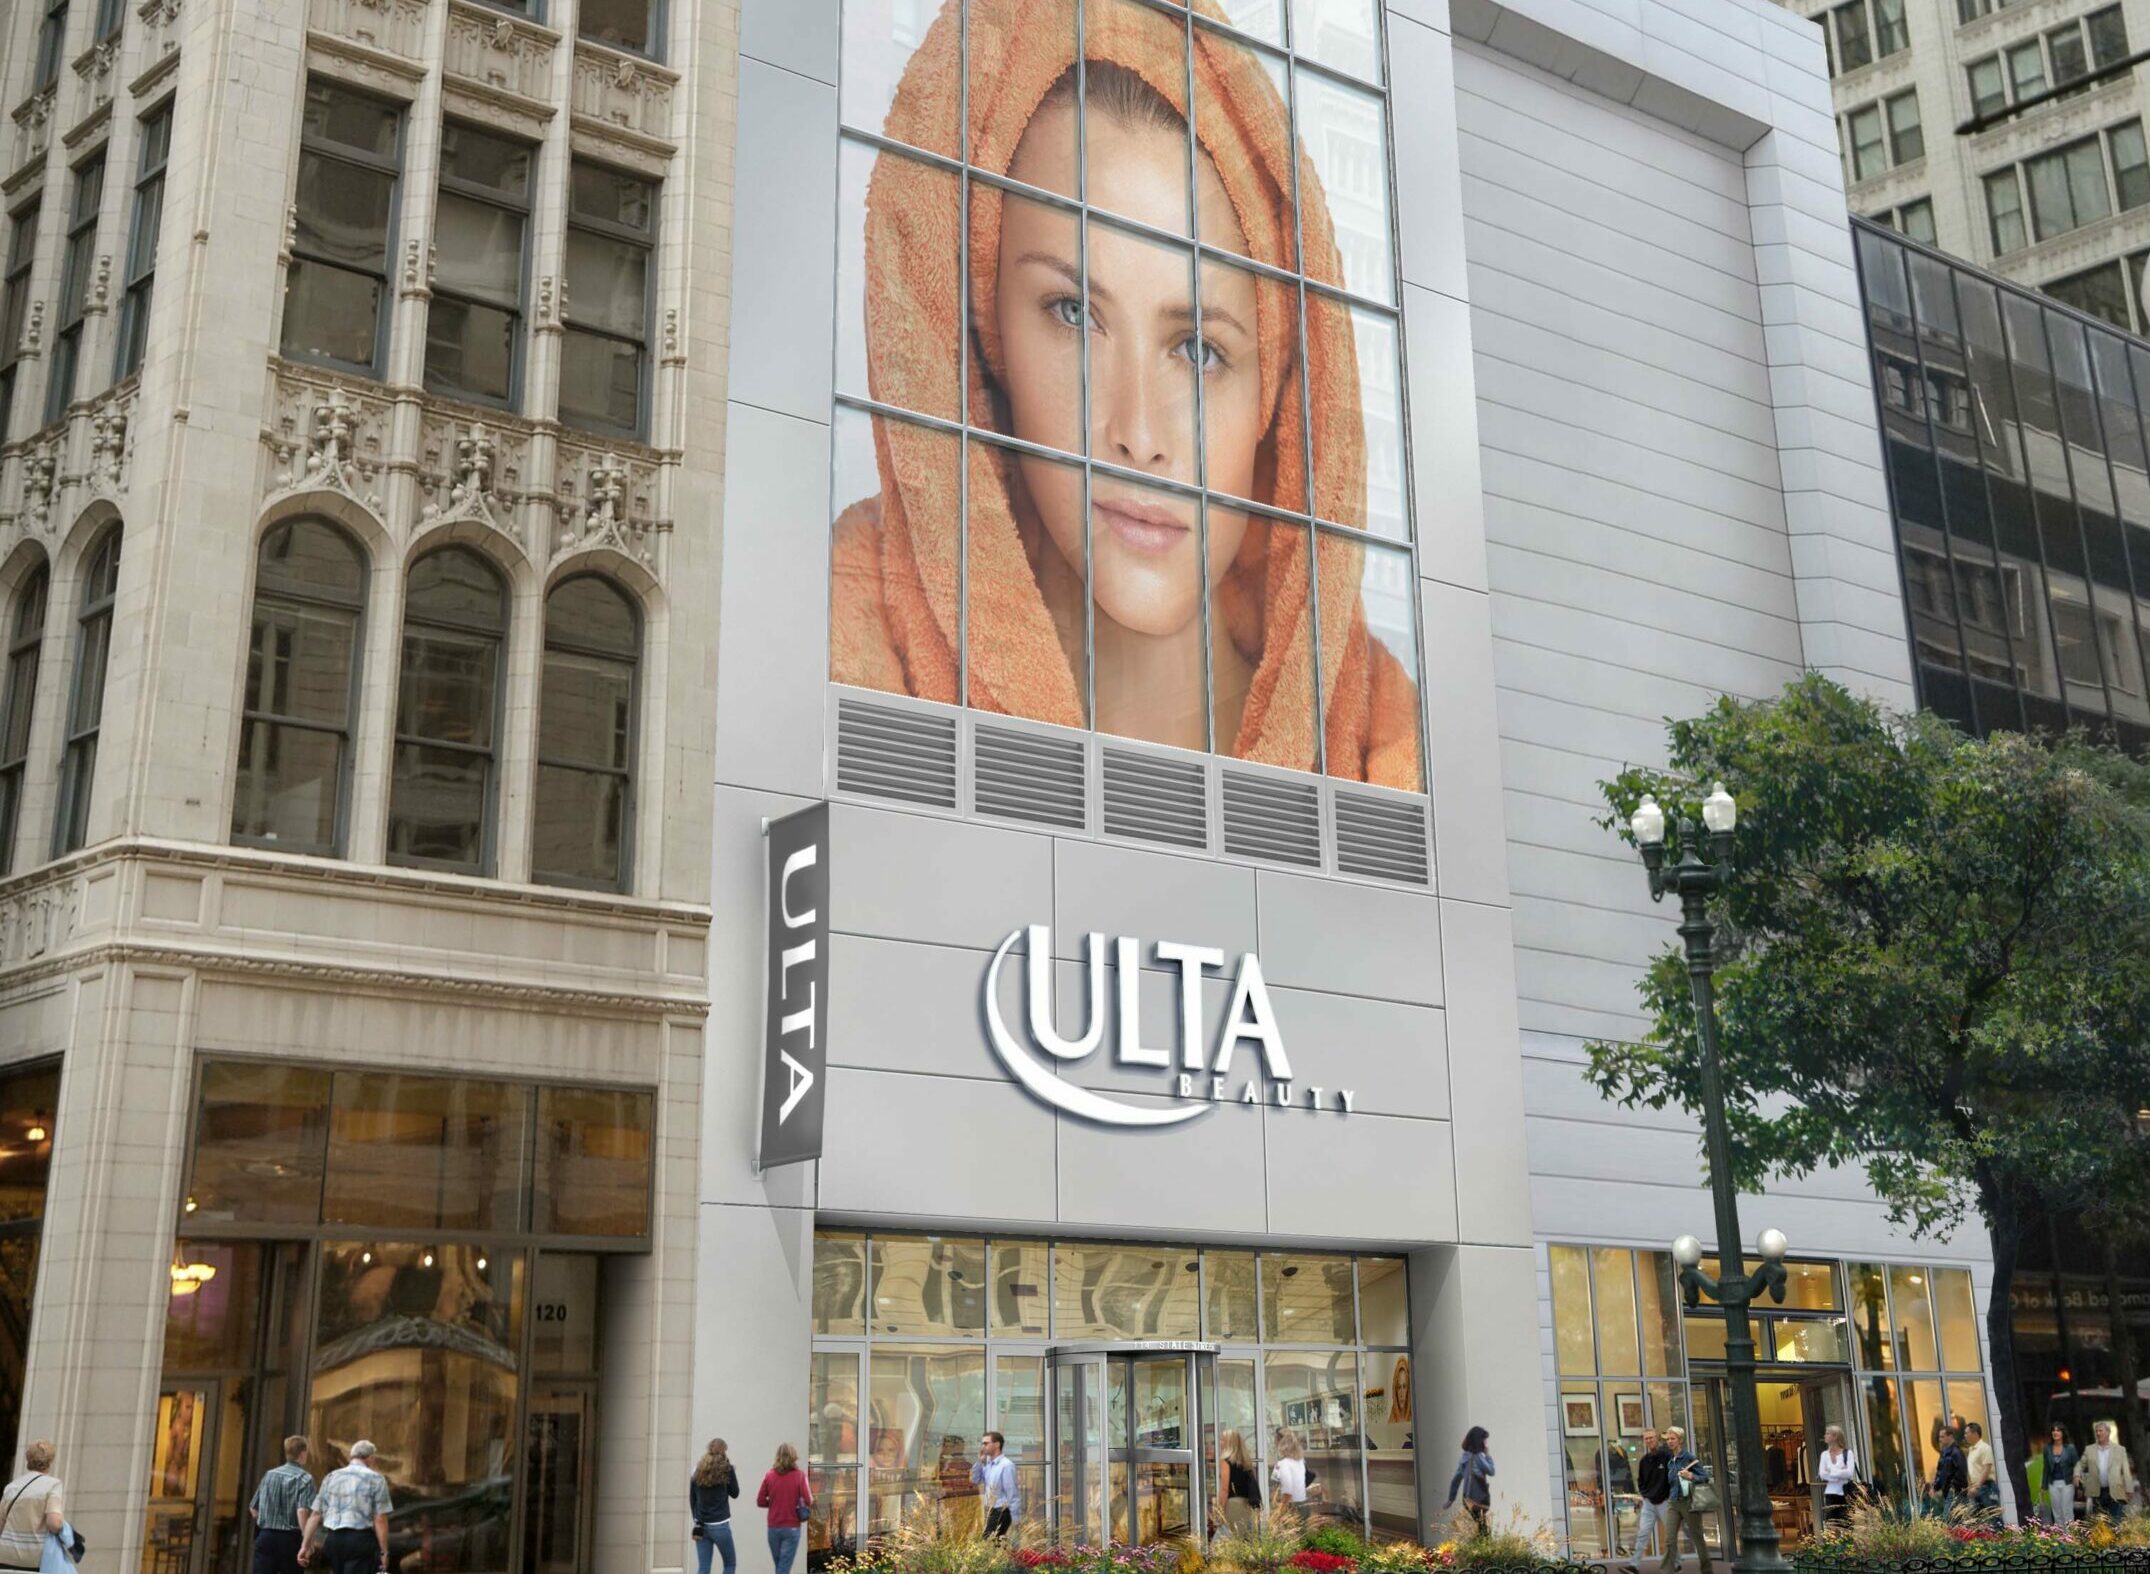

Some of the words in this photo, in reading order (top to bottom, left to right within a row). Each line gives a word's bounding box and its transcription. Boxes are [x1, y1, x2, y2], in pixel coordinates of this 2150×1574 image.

[778, 844, 817, 1126] ULTA
[1028, 924, 1293, 1080] ULTA
[1178, 1073, 1355, 1112] BEAUTY
[536, 1304, 567, 1322] 120
[1159, 1341, 1188, 1350] STATE
